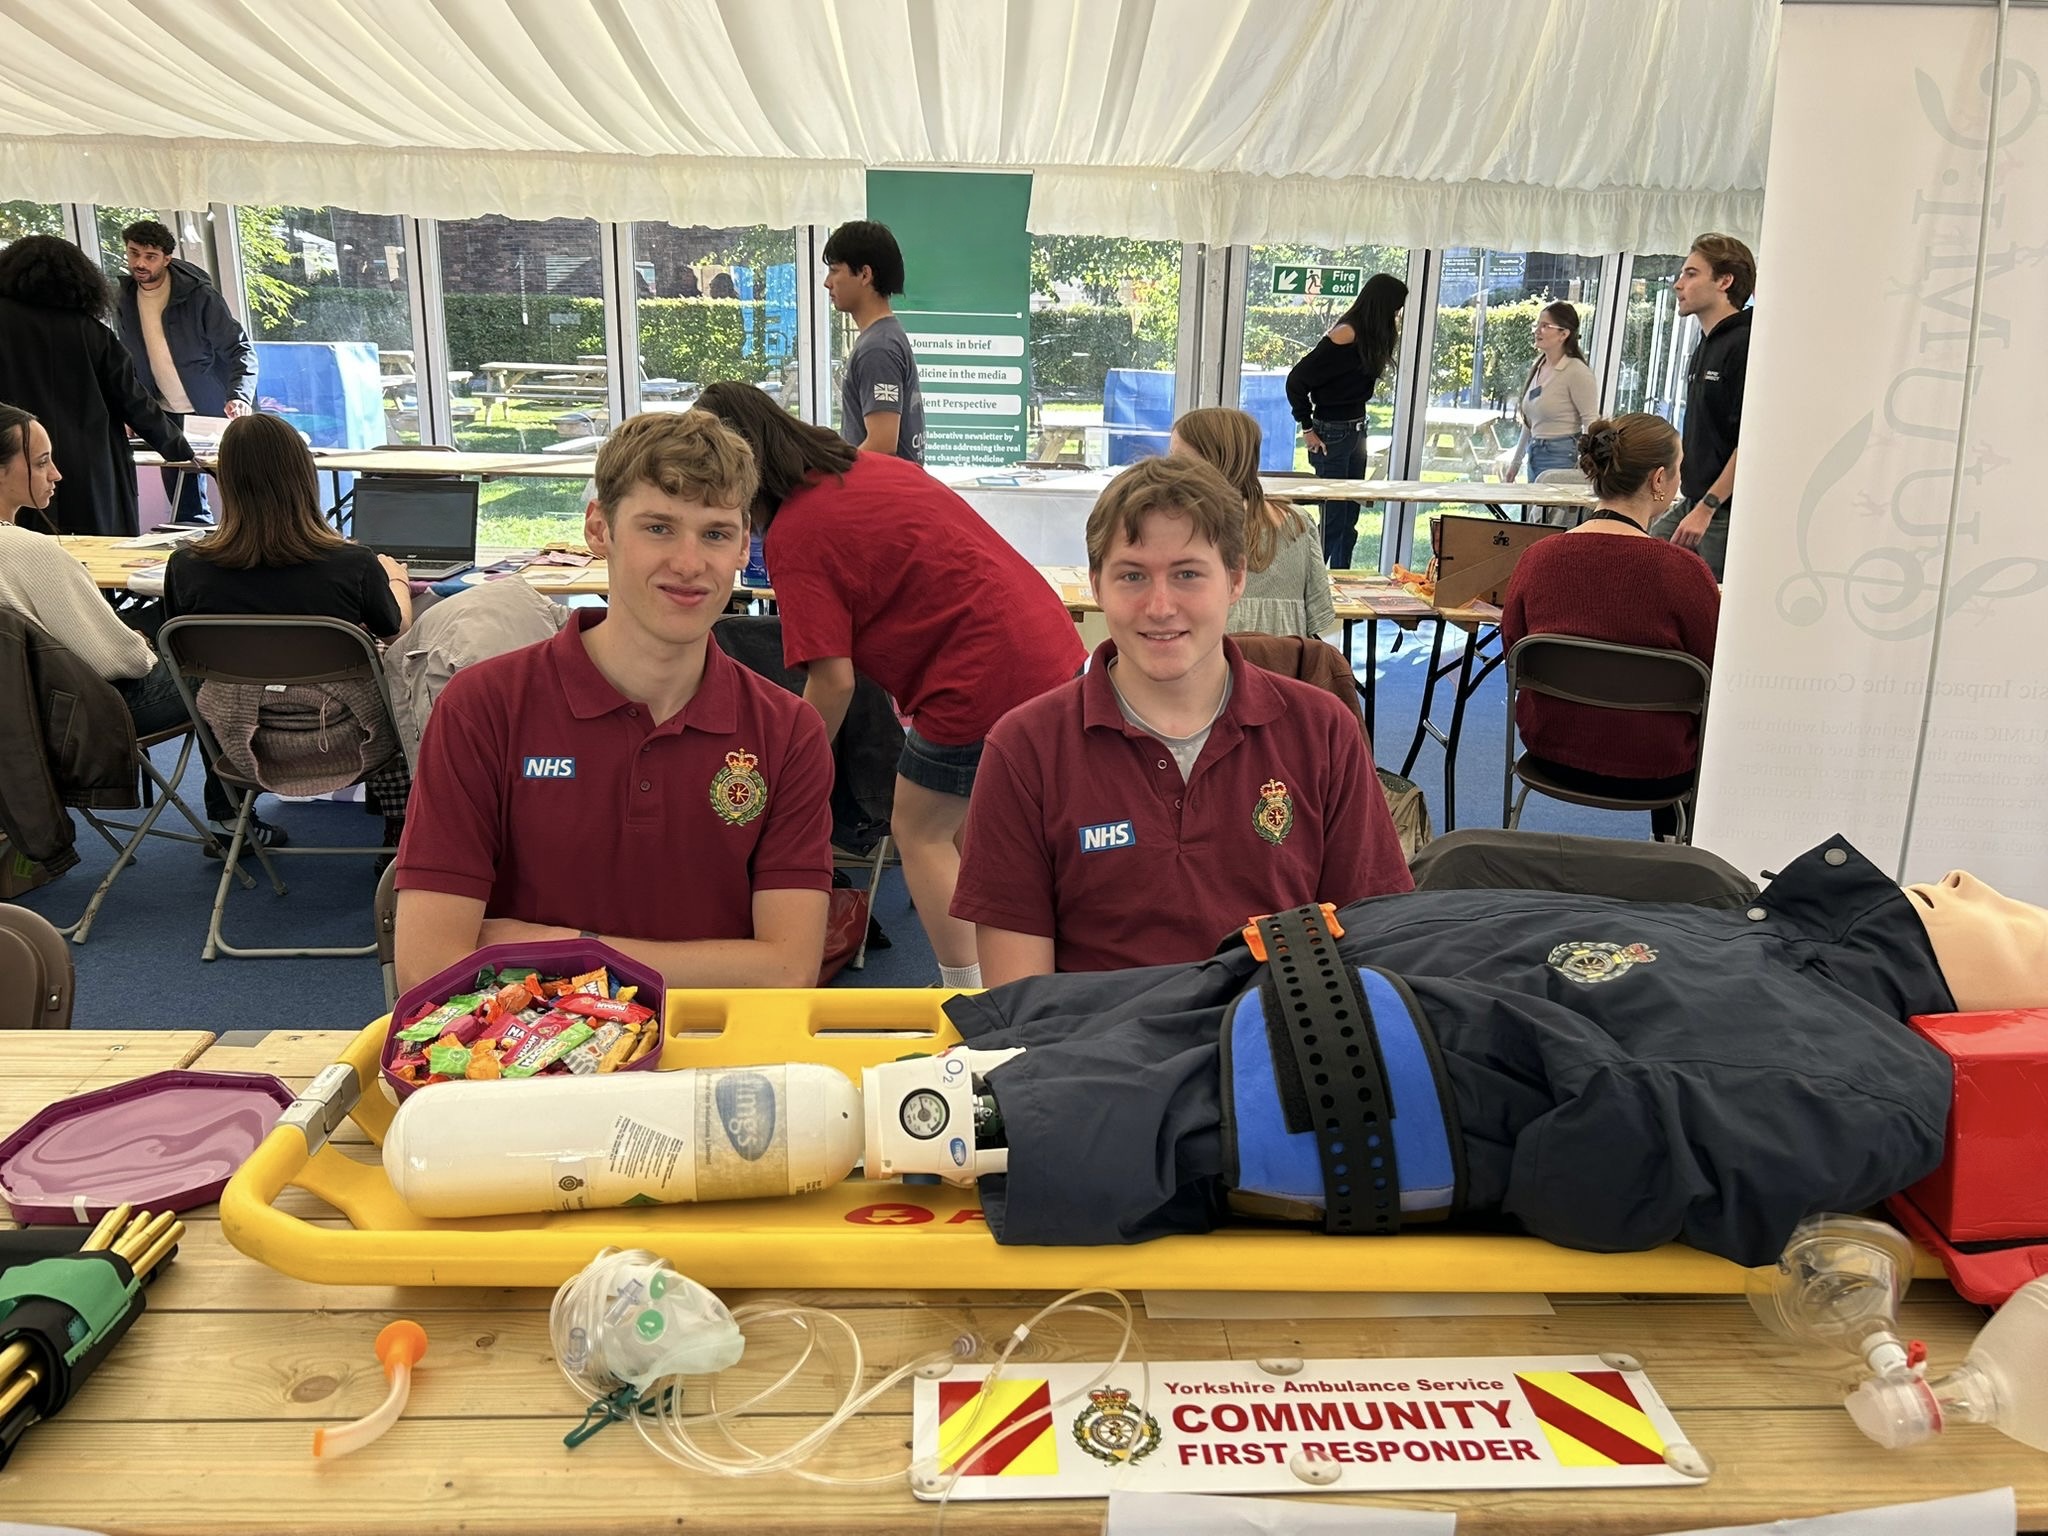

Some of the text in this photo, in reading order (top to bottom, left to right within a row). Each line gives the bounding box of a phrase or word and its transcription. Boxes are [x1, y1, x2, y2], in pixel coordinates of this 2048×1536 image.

[1333, 270, 1356, 282] Fire
[1332, 282, 1354, 293] exit
[911, 339, 992, 350] Journals in brief
[919, 368, 1007, 380] dicine in the media
[921, 398, 997, 410] dent Perspective
[926, 431, 1013, 442] laborative newsletter by
[925, 442, 952, 450] tudents
[953, 443, 992, 453] addressing
[993, 444, 1005, 452] the
[937, 454, 970, 463] changing
[971, 454, 1004, 463] Medicine
[525, 758, 572, 777] NHS
[1084, 823, 1130, 849] NHS
[1164, 1378, 1504, 1395] Yorkshire Ambulance Service
[1172, 1399, 1512, 1433] COMMUNITY
[1178, 1439, 1541, 1466] FIRST RESPONDER
